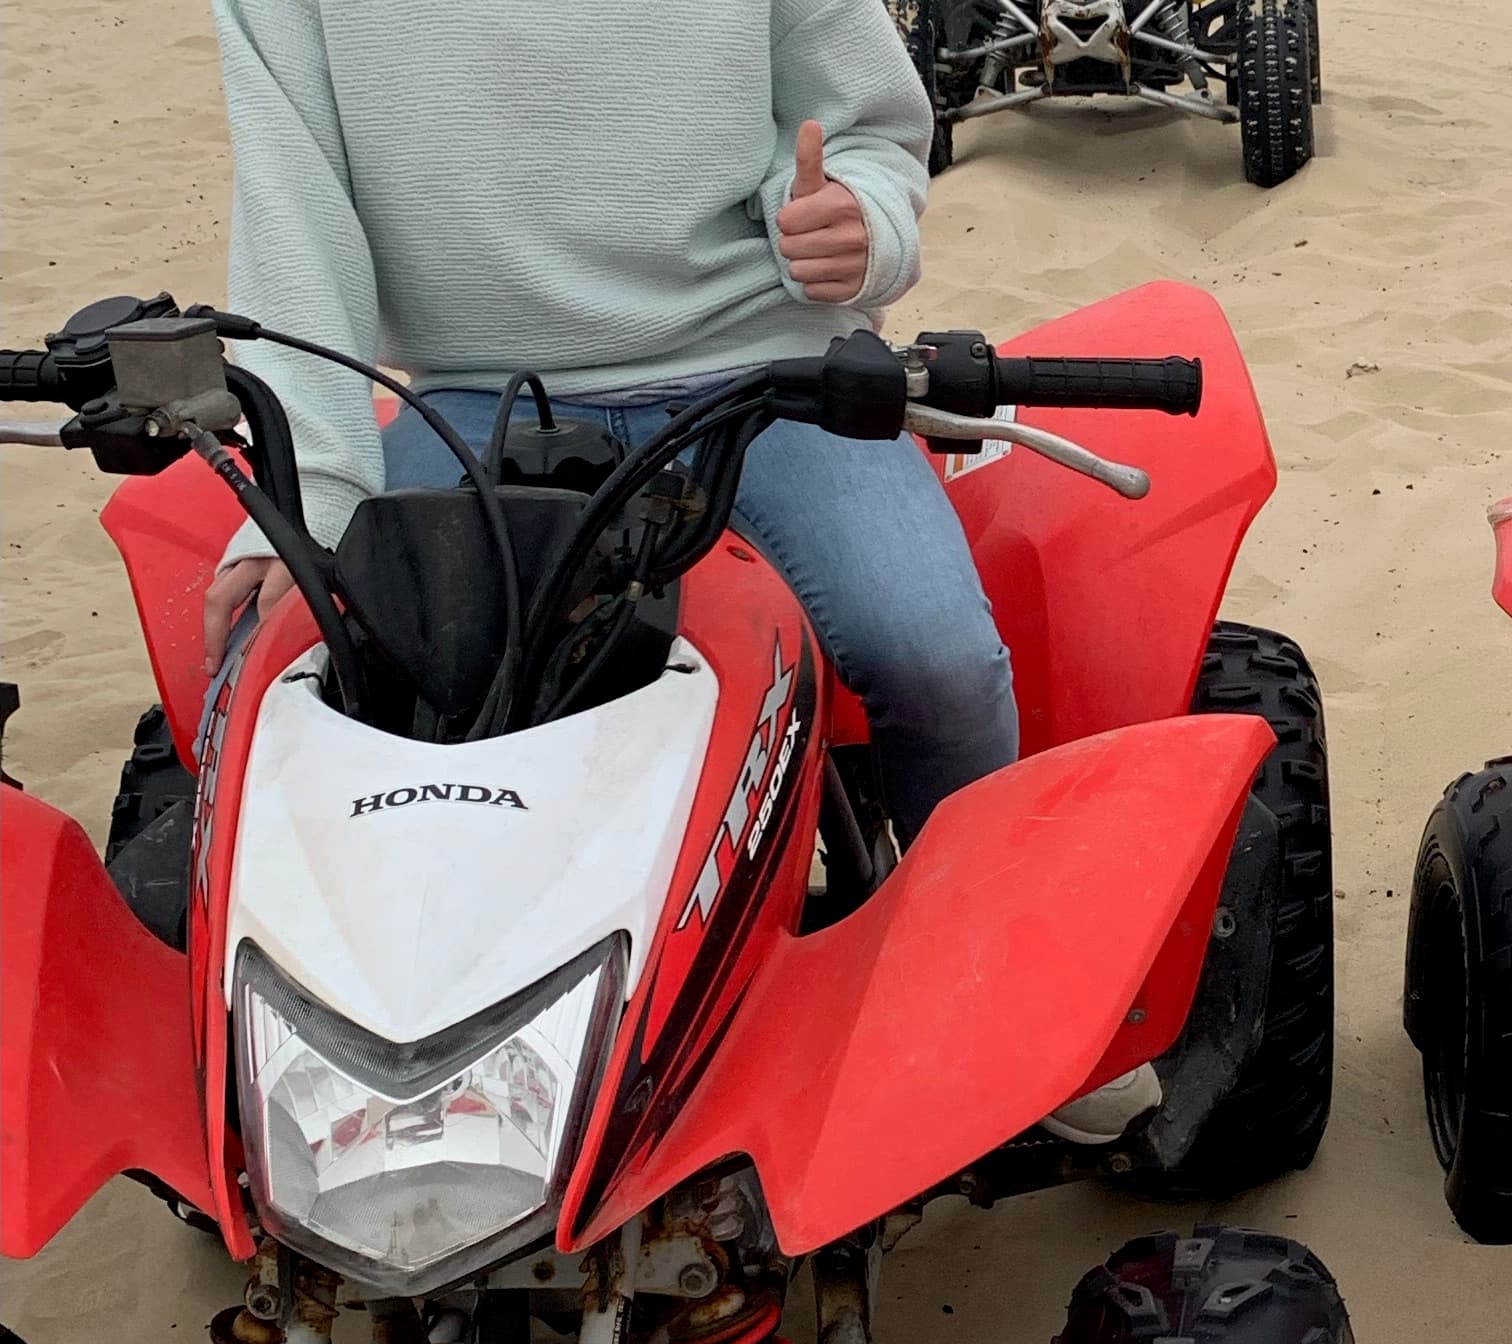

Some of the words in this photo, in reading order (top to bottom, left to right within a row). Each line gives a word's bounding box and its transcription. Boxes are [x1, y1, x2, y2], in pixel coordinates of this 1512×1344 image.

[349, 783, 529, 818] HONDA
[674, 629, 796, 932] TRX
[748, 707, 801, 861] 250EX
